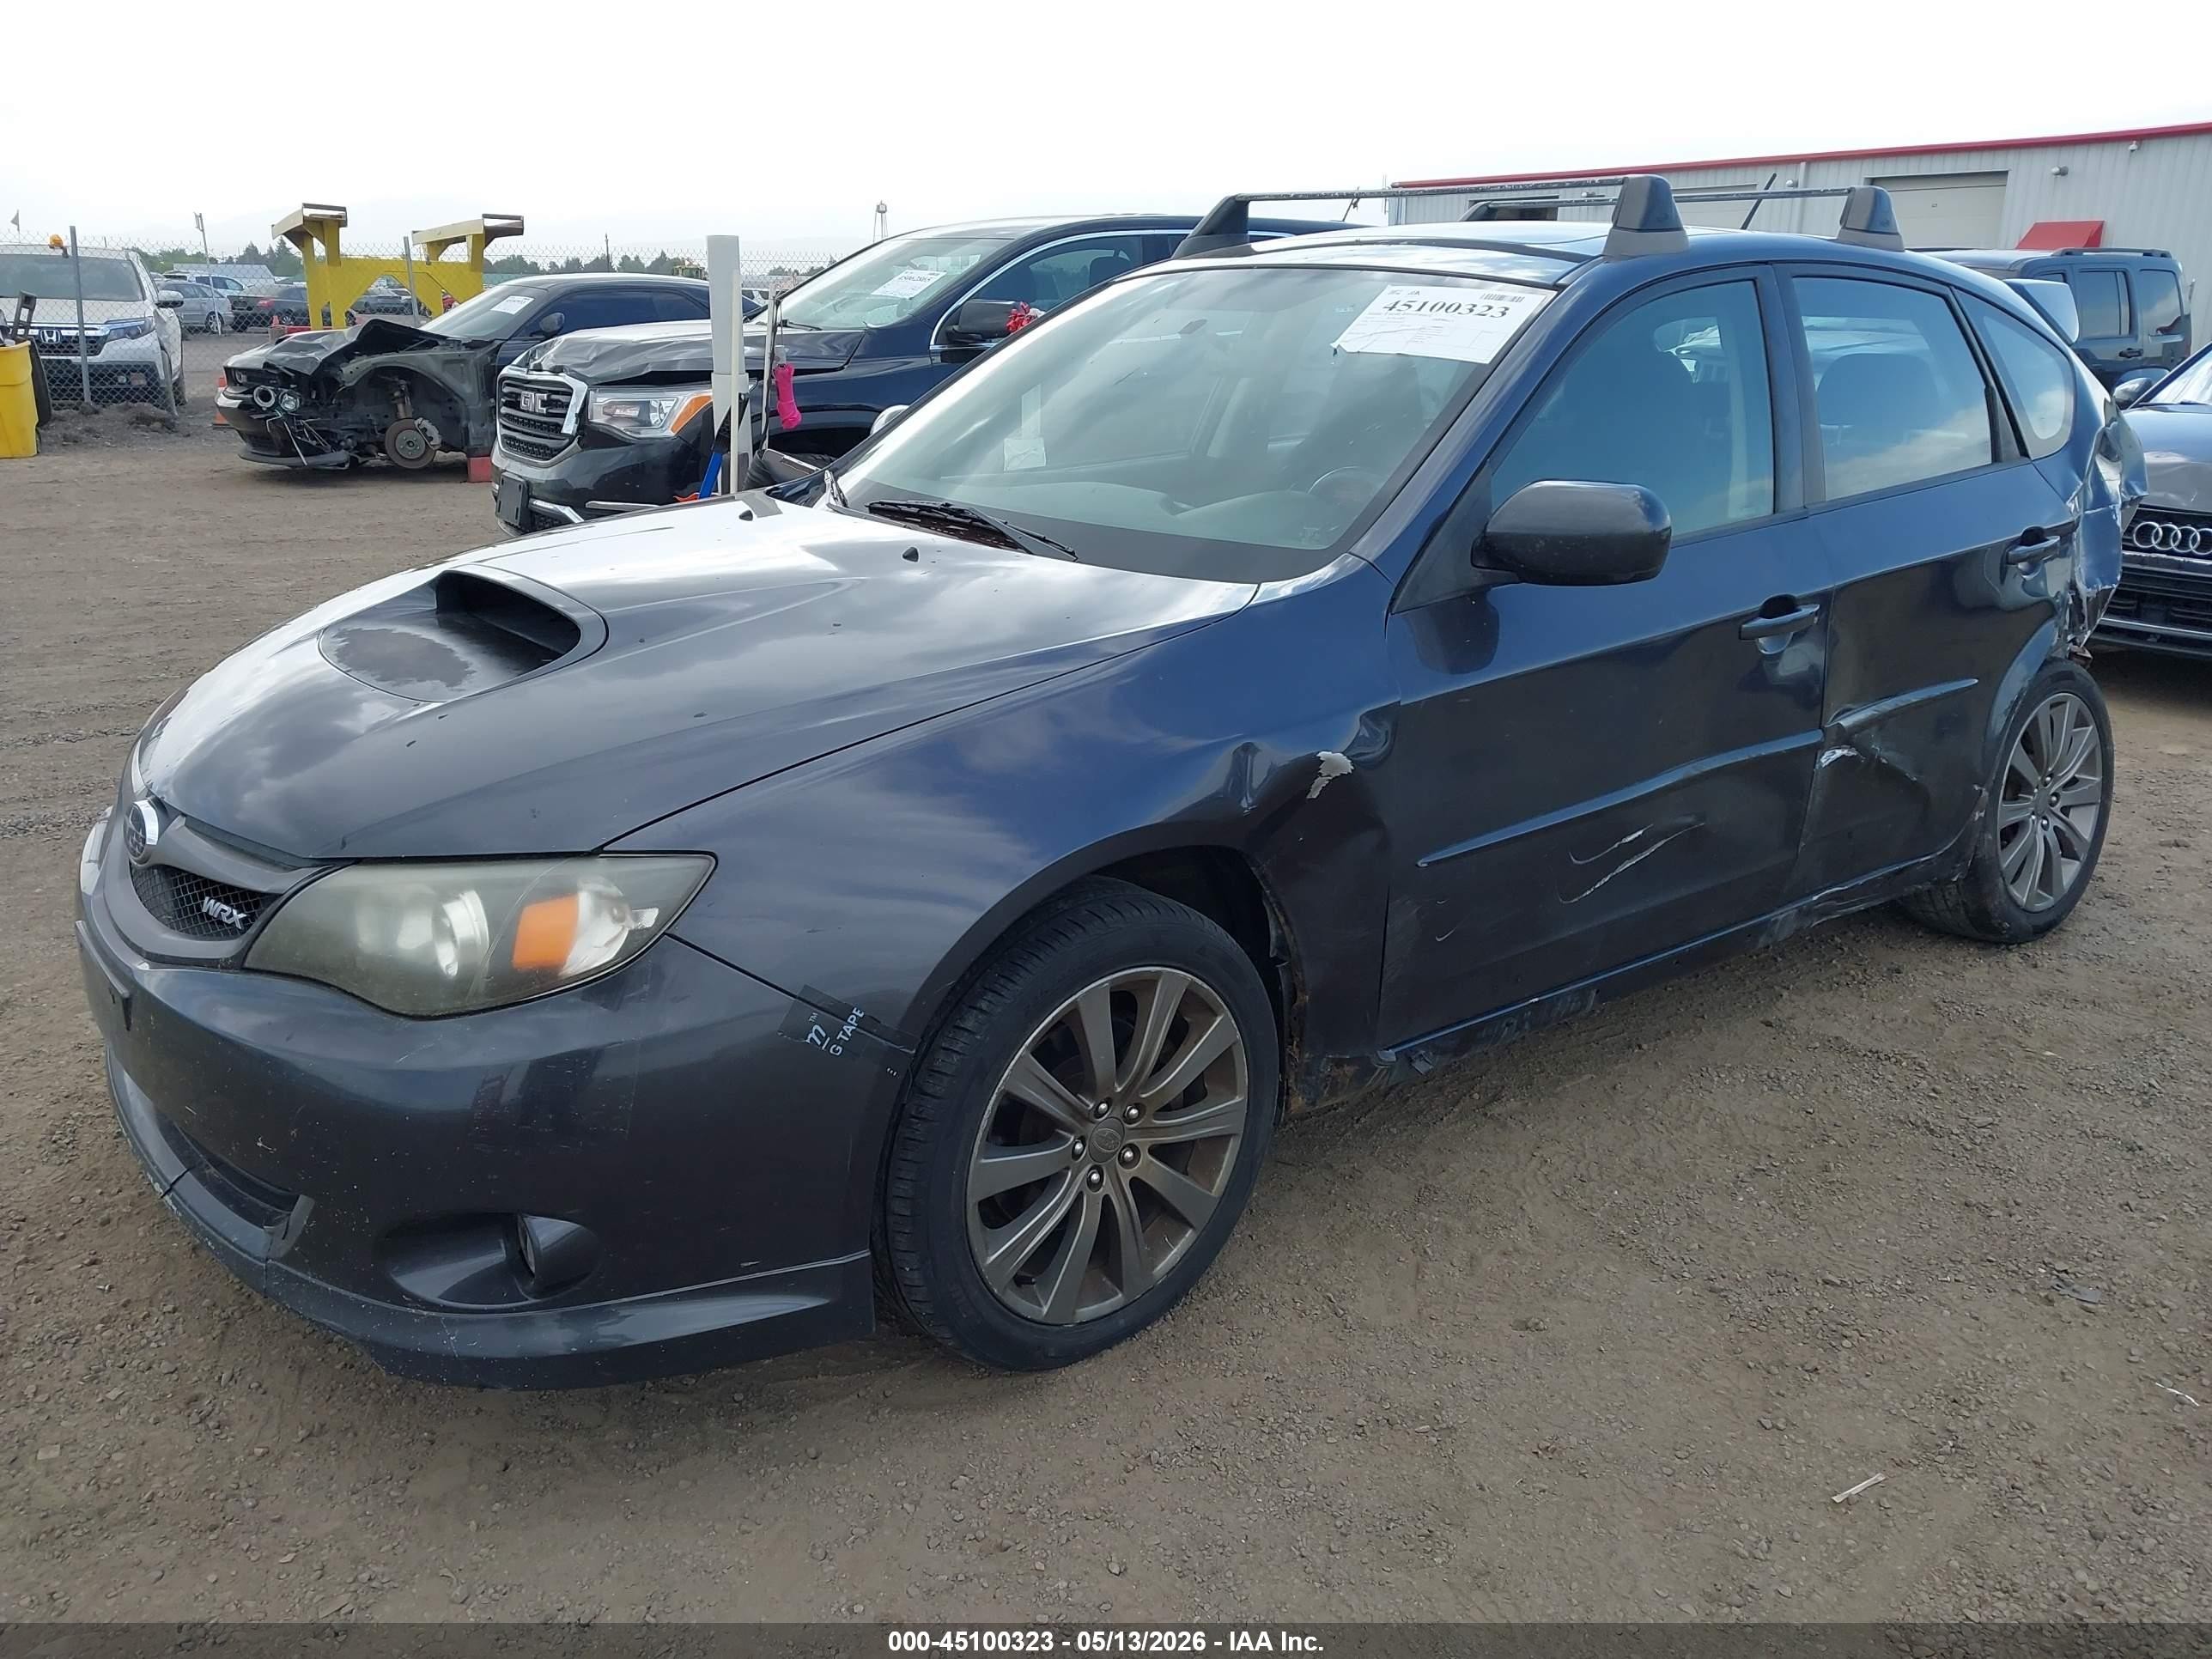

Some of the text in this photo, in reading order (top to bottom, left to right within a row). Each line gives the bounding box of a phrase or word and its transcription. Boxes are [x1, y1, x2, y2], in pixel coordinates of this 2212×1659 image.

[1382, 300, 1510, 319] 45100323
[202, 896, 247, 930] WRX
[836, 1006, 865, 1042] TAPE
